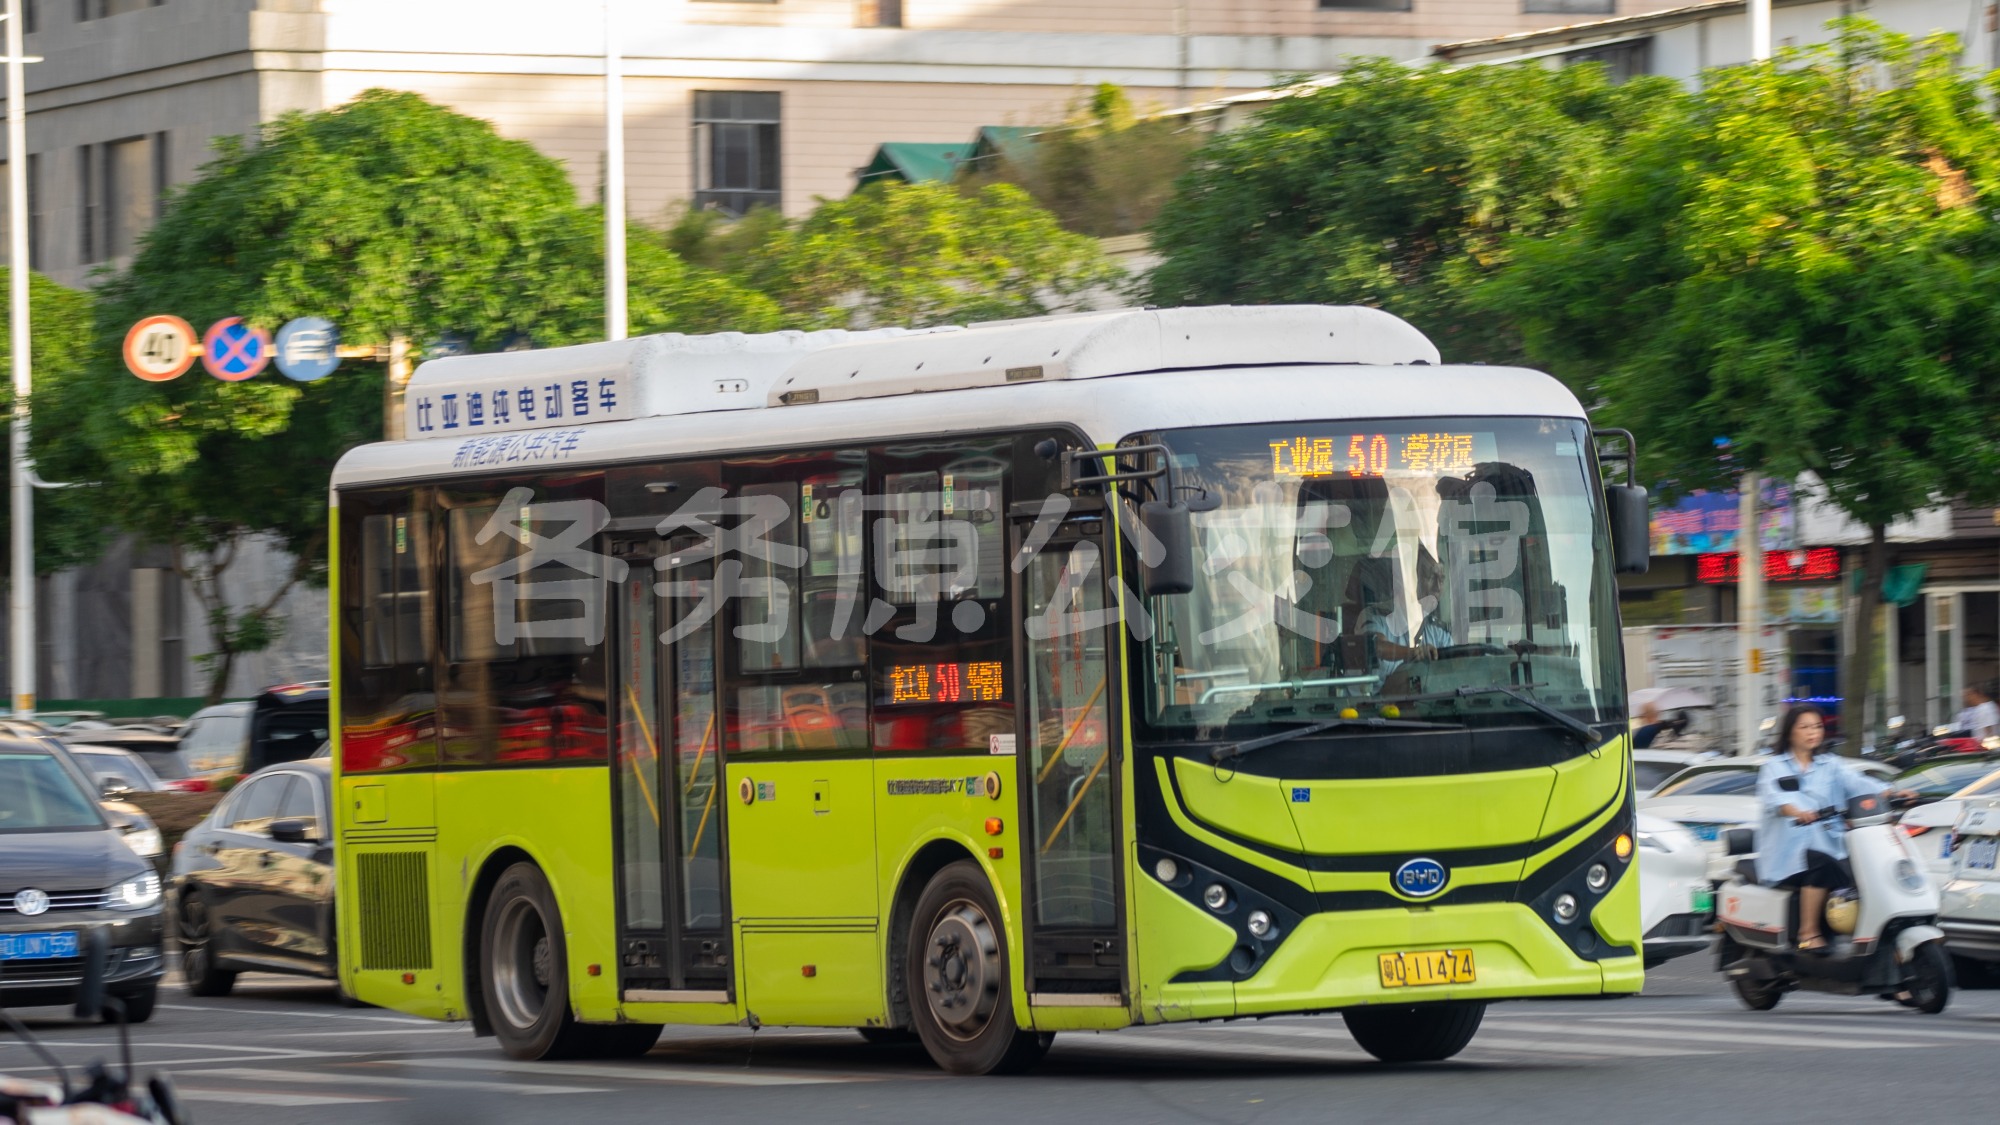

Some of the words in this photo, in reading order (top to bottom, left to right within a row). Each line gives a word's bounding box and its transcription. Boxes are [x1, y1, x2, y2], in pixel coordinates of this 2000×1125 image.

[140, 332, 178, 364] 40
[417, 378, 617, 432] 比亚迪纯电动客车
[452, 428, 586, 468] 新能源公共汽车
[1348, 434, 1388, 478] 50
[936, 663, 960, 702] 50
[1403, 868, 1440, 886] BYD
